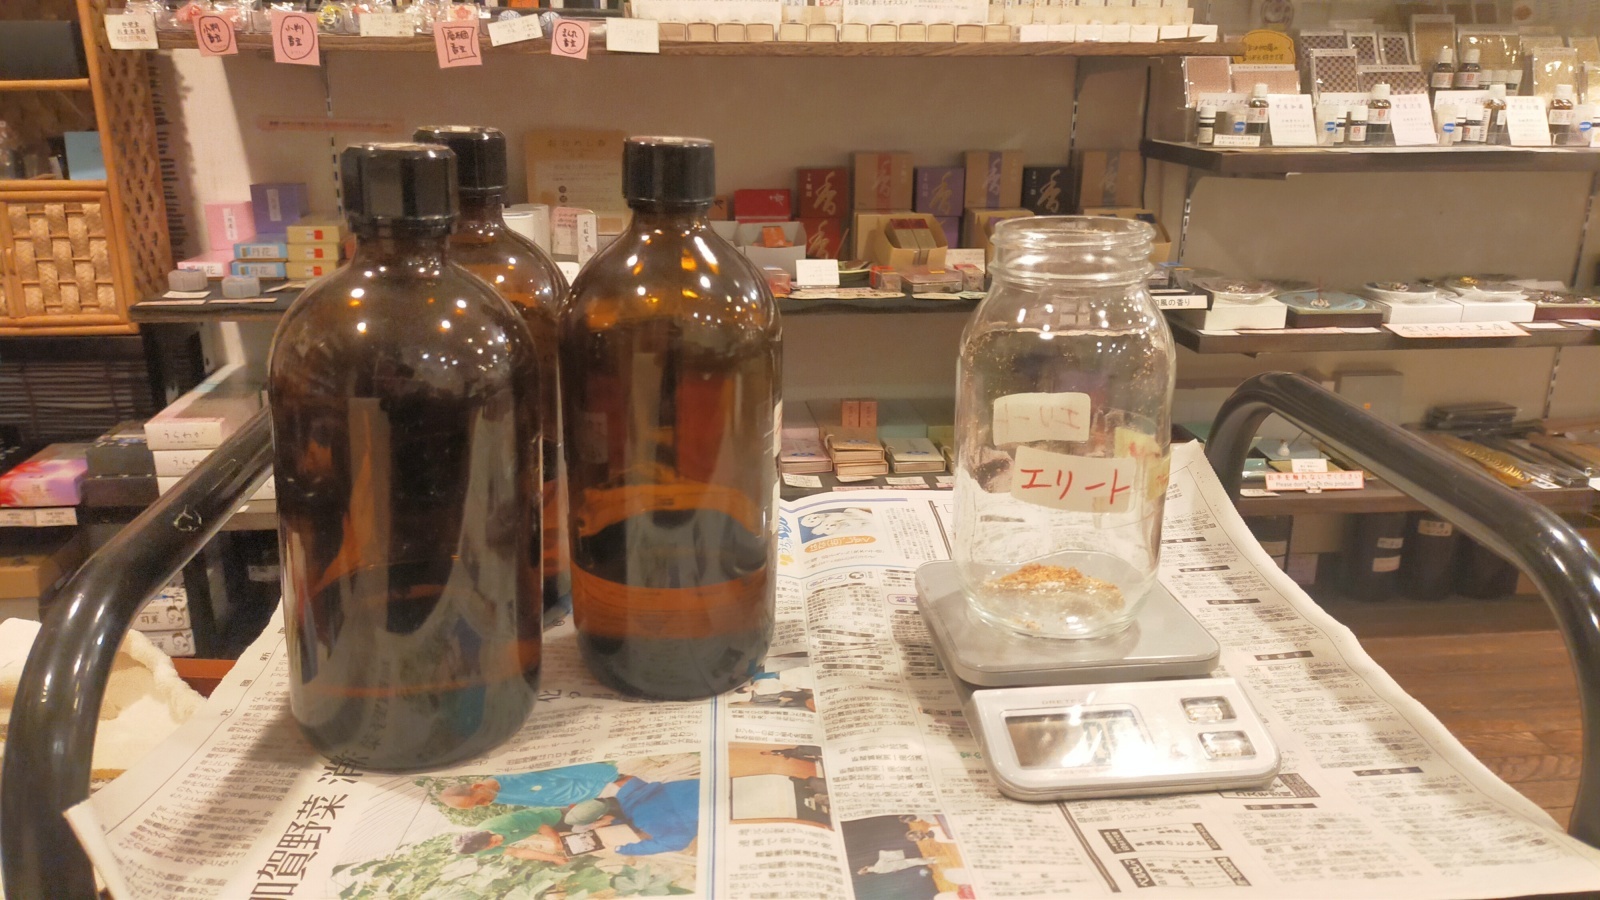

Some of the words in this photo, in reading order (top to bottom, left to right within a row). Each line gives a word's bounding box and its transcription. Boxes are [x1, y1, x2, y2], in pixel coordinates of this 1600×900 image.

[285, 23, 305, 35] 小判
[1019, 467, 1131, 505] エリート
